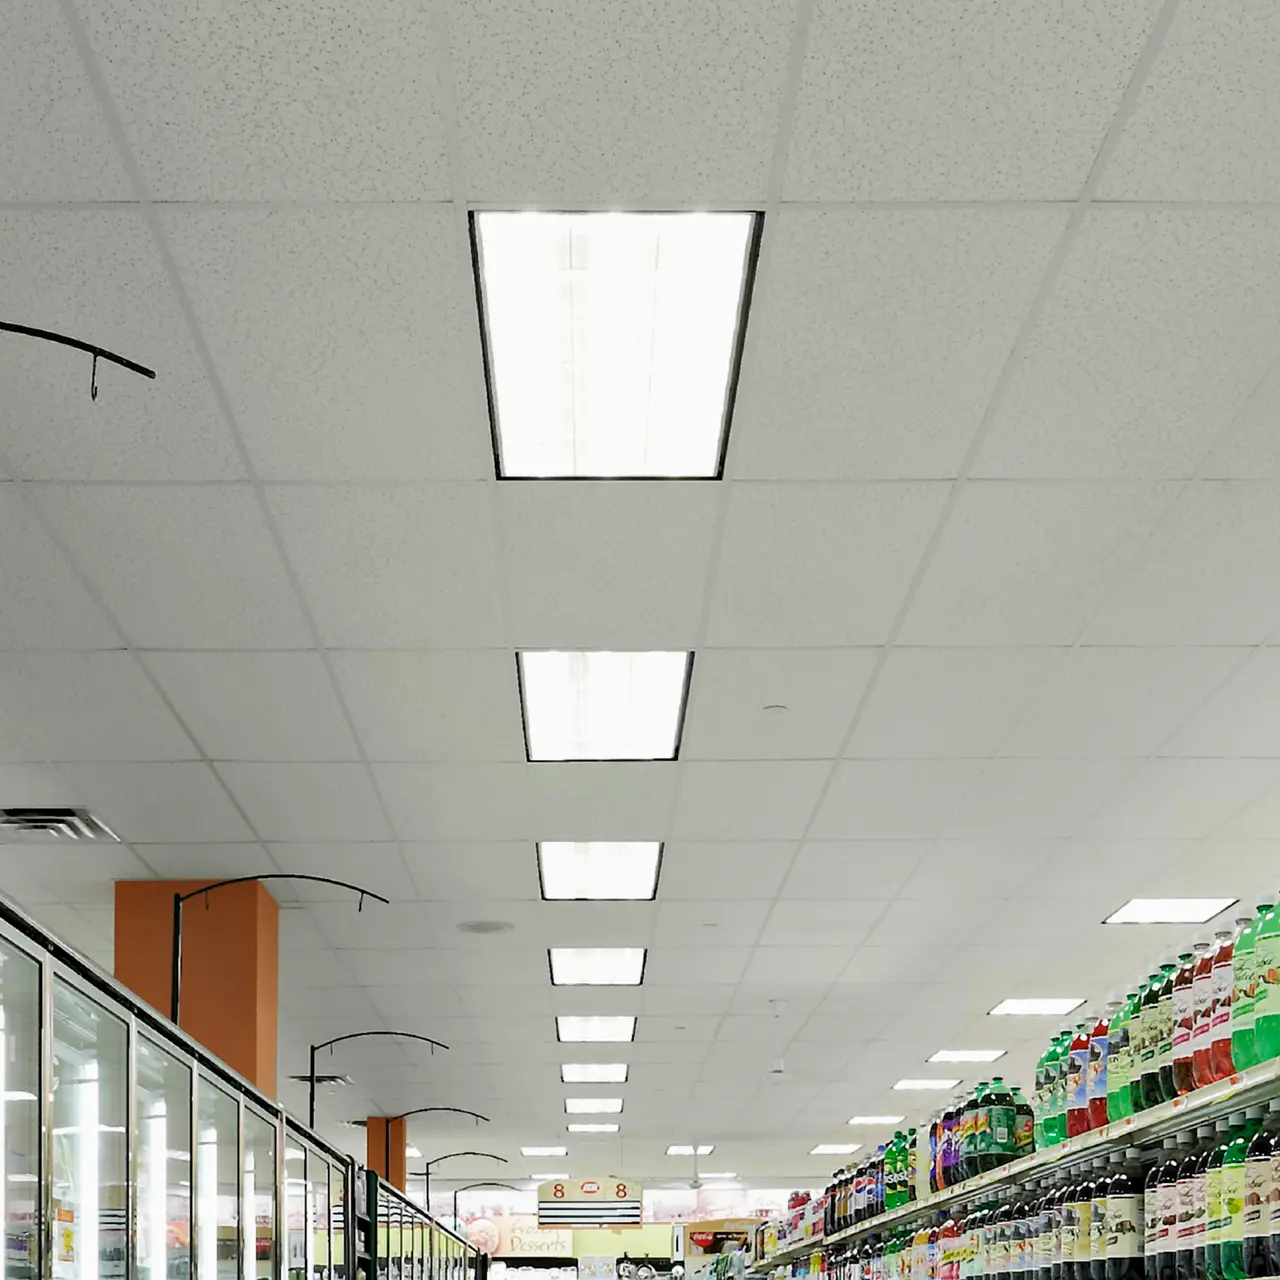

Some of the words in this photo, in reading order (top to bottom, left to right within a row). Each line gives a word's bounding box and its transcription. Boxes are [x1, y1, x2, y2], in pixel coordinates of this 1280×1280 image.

[553, 1183, 565, 1198] 8
[616, 1183, 627, 1198] 8
[510, 1235, 566, 1252] Desserts
